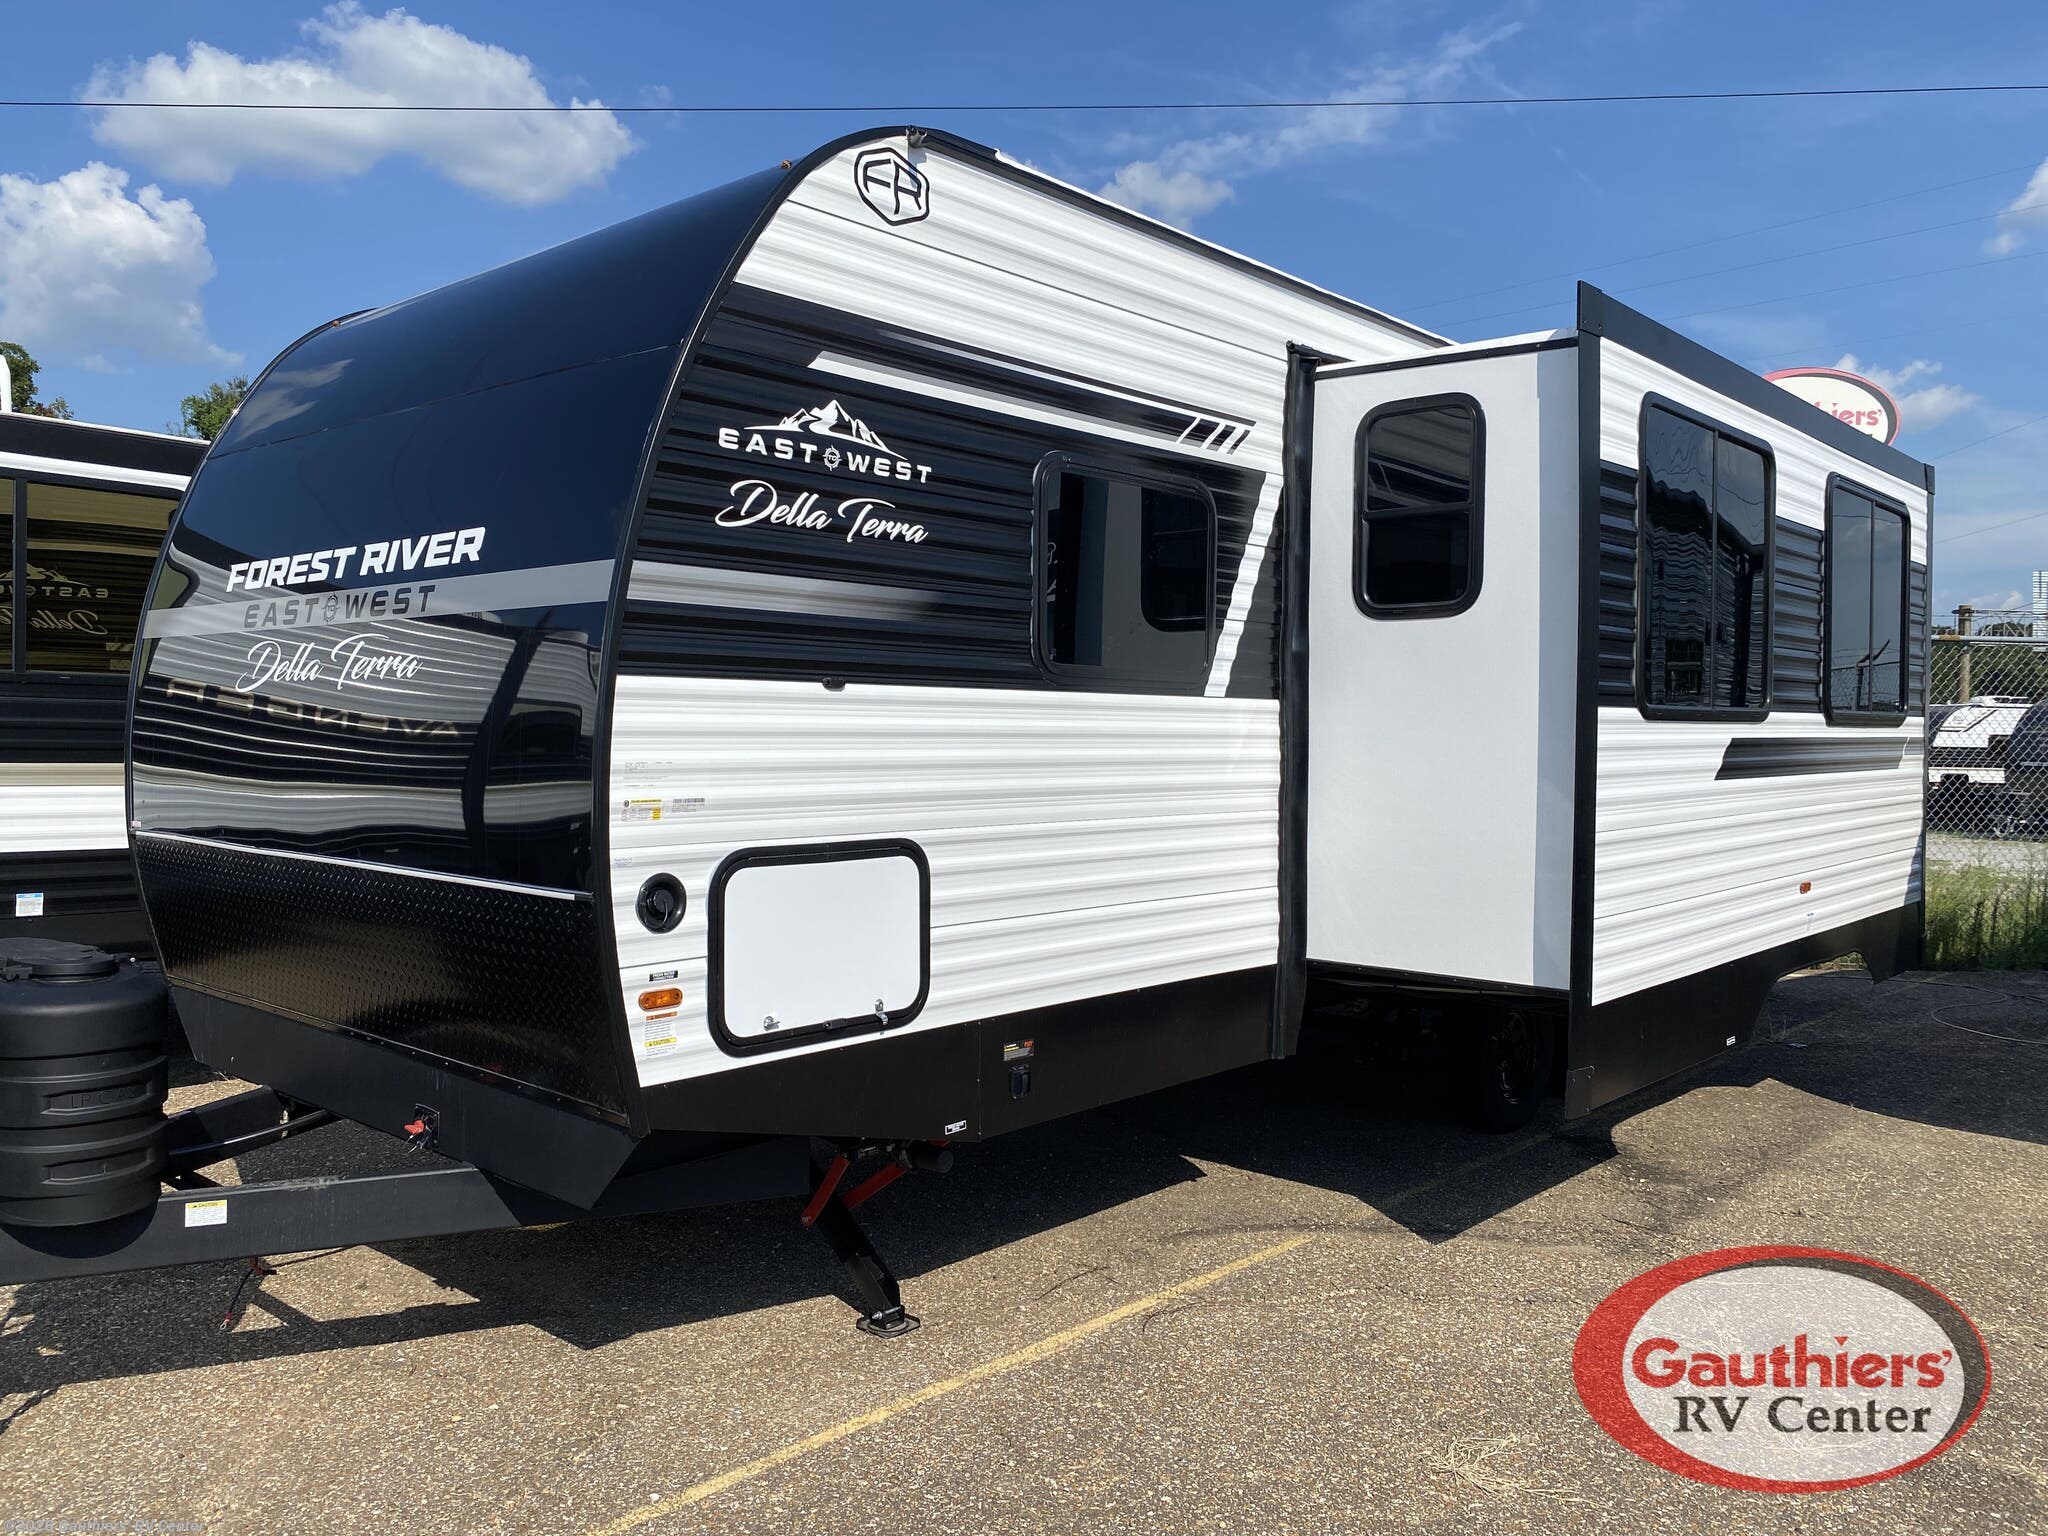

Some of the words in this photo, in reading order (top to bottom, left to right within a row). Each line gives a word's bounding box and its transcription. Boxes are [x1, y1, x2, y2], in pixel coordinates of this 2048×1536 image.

[718, 427, 818, 464] EAST
[847, 451, 932, 483] WEST
[715, 479, 833, 530] Della
[837, 498, 929, 543] Terra
[225, 546, 358, 593] FOREST
[359, 526, 486, 577] RIVER
[243, 597, 320, 629] EAST
[345, 585, 436, 619] WEST
[235, 640, 326, 693] Della
[330, 633, 424, 691] Terra
